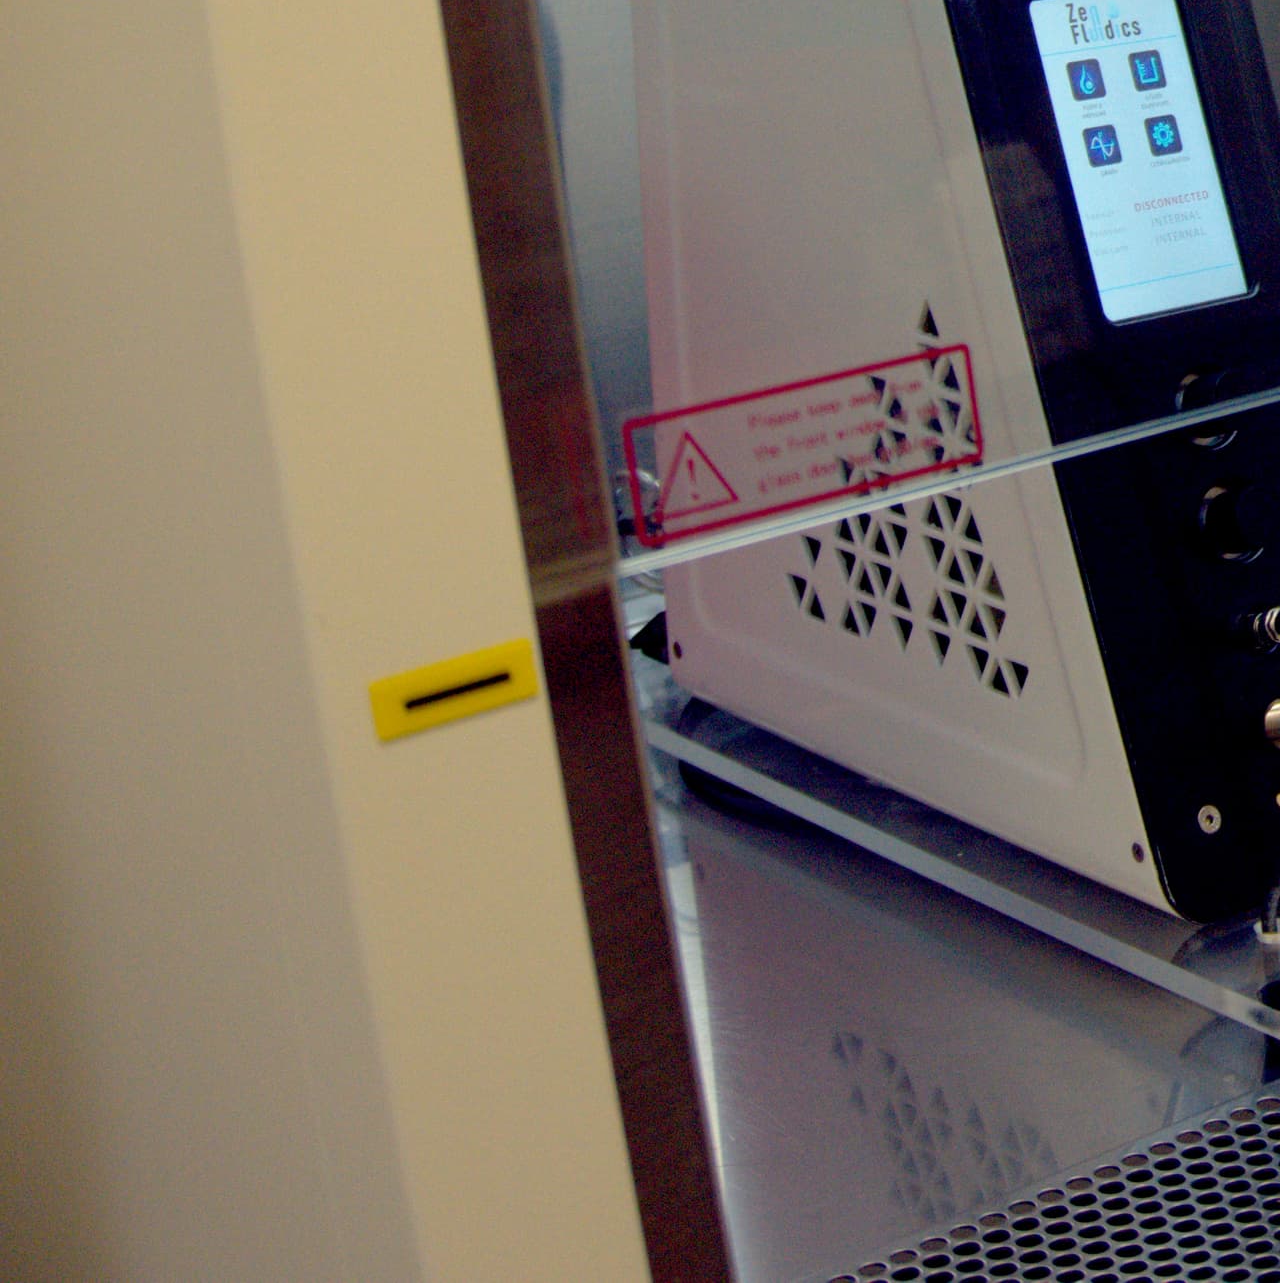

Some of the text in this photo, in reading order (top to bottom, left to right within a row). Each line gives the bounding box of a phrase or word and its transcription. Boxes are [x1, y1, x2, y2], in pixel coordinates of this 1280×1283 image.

[1134, 190, 1209, 212] DISCONNECTED
[1151, 209, 1202, 228] INTERNAL
[1154, 227, 1208, 246] INTERNAL
